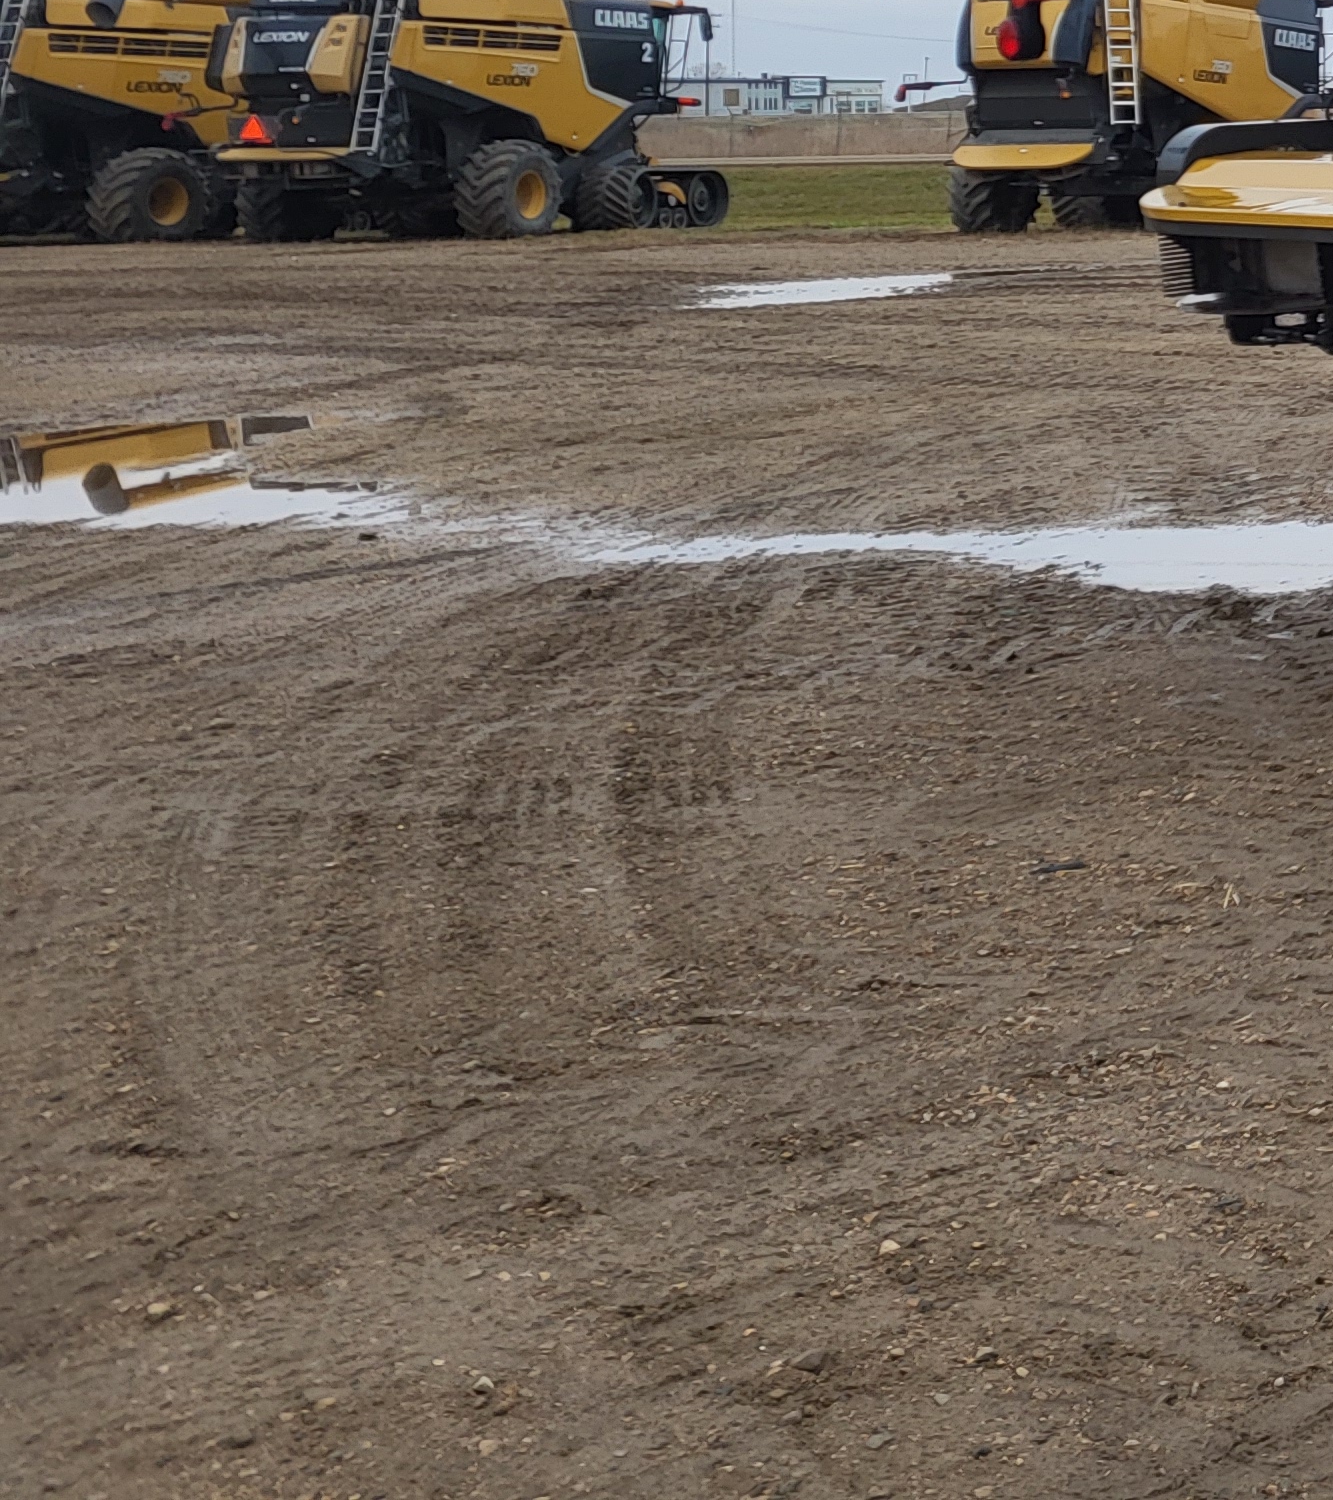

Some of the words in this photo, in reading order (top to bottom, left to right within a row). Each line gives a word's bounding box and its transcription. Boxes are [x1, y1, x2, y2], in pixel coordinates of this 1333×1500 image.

[594, 8, 650, 30] CLAAS
[253, 30, 310, 43] LEXION
[1273, 28, 1317, 51] CLAAS
[641, 42, 654, 63] 2
[126, 80, 183, 94] LEXION
[486, 74, 531, 87] LEXION
